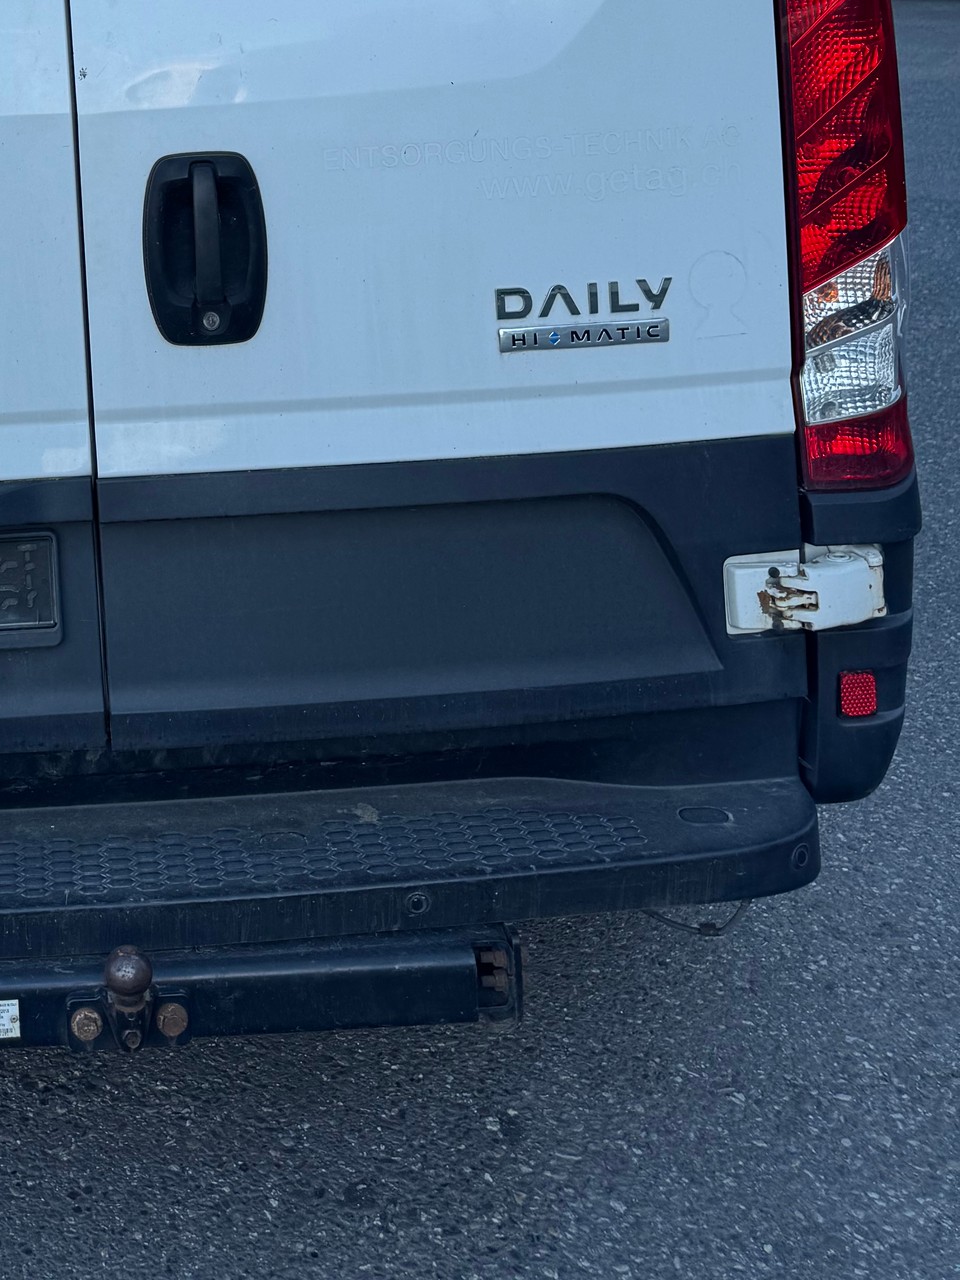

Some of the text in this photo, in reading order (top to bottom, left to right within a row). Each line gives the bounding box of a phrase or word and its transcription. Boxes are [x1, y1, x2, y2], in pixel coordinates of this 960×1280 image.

[322, 122, 742, 171] ENTSORGUNGS-TECHNIK AG
[479, 157, 743, 202] www.getag.ch
[494, 276, 672, 321] DAILY
